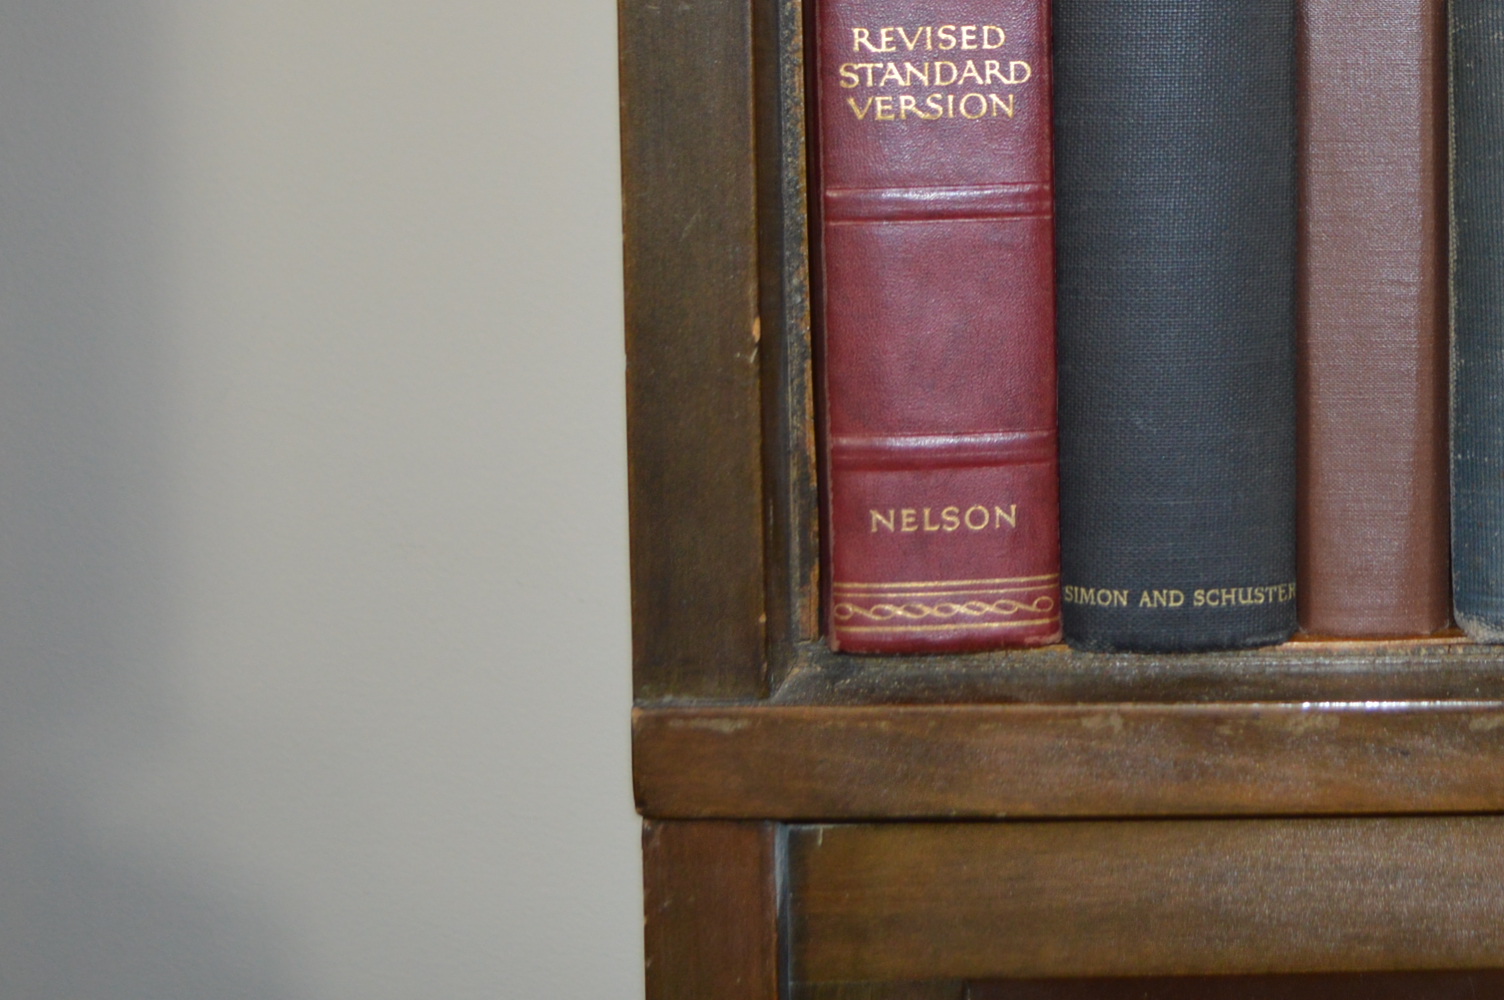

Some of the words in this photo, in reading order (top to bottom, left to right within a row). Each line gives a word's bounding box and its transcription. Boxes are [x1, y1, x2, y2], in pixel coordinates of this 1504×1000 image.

[852, 25, 1006, 52] REVISED
[839, 60, 1032, 88] STANDARD
[847, 93, 1015, 120] VERSION
[871, 504, 1017, 532] NELSON
[1064, 586, 1129, 607] SIMON
[1139, 589, 1185, 608] AND
